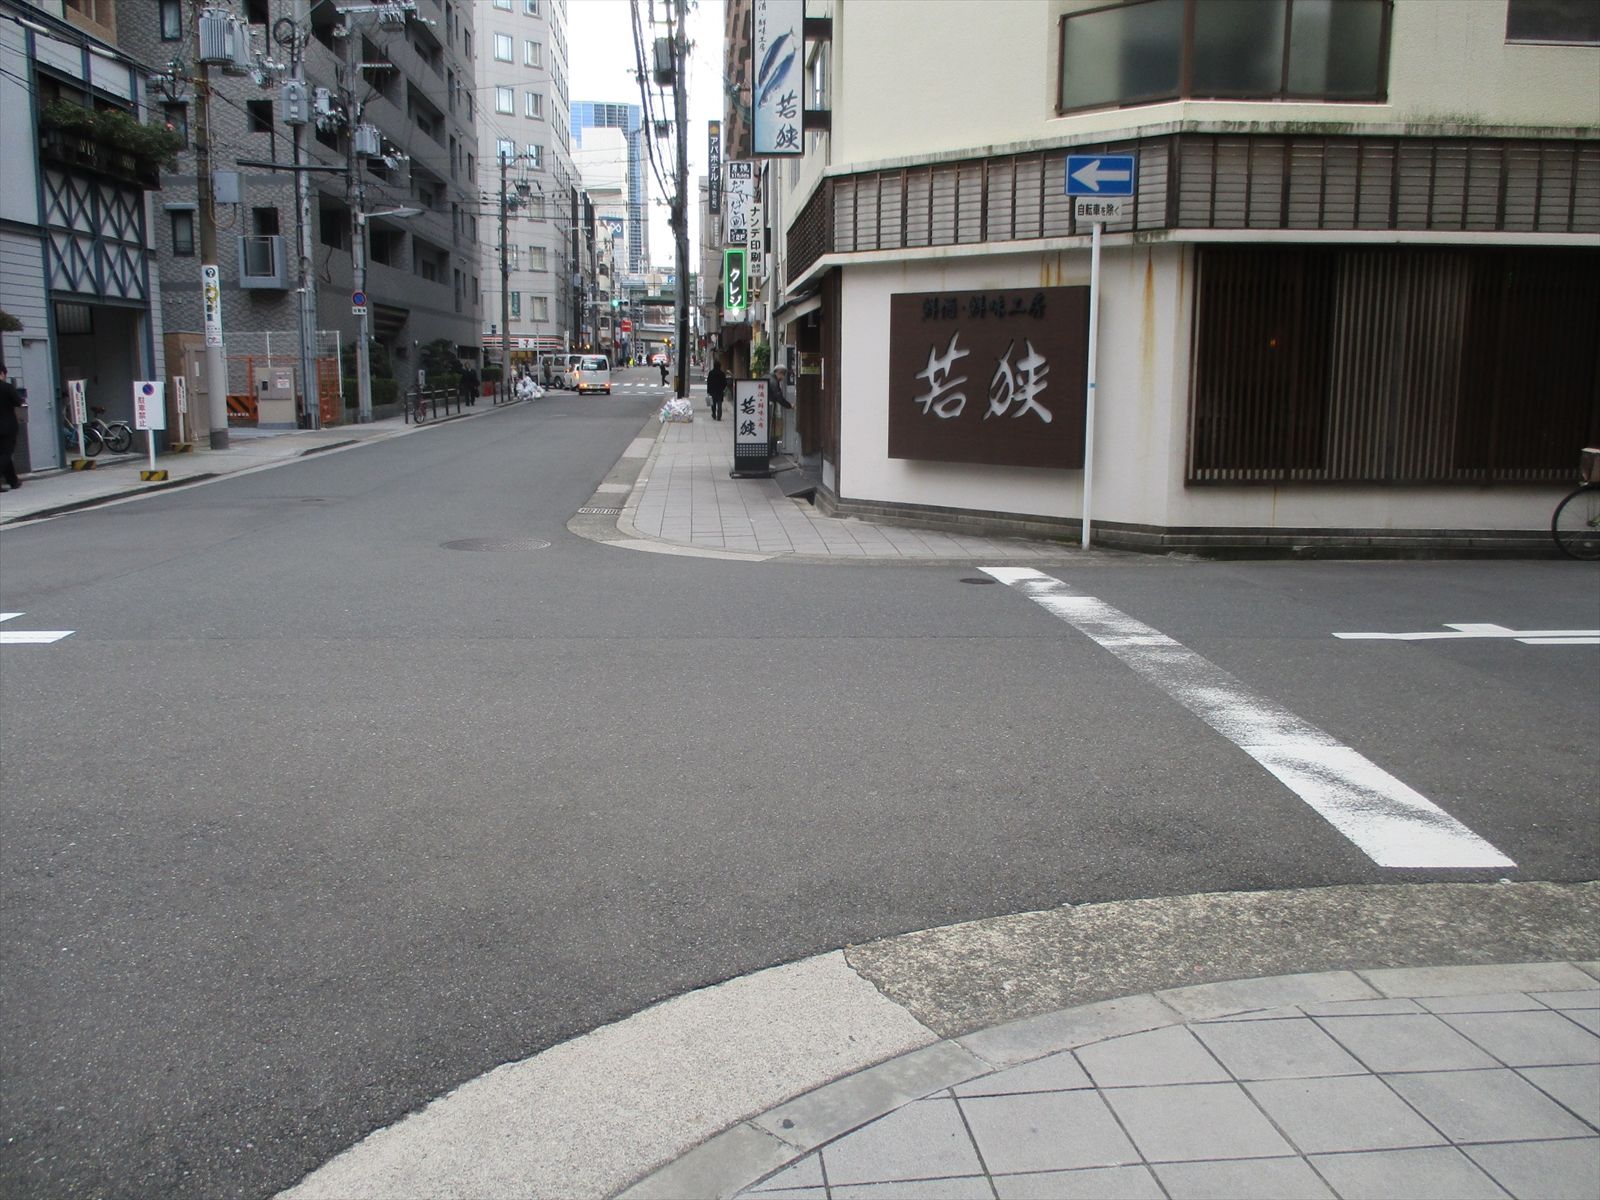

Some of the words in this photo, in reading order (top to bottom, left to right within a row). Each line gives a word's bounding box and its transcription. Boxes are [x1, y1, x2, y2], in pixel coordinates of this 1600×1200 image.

[775, 89, 799, 149] 若狭
[710, 137, 719, 181] アパホテル
[1077, 203, 1119, 216] 自転車を除く
[750, 206, 761, 262] ナンデ印刷
[913, 329, 1053, 424] 若狭
[138, 396, 147, 427] 駐車禁止
[739, 395, 757, 436] 若狭
